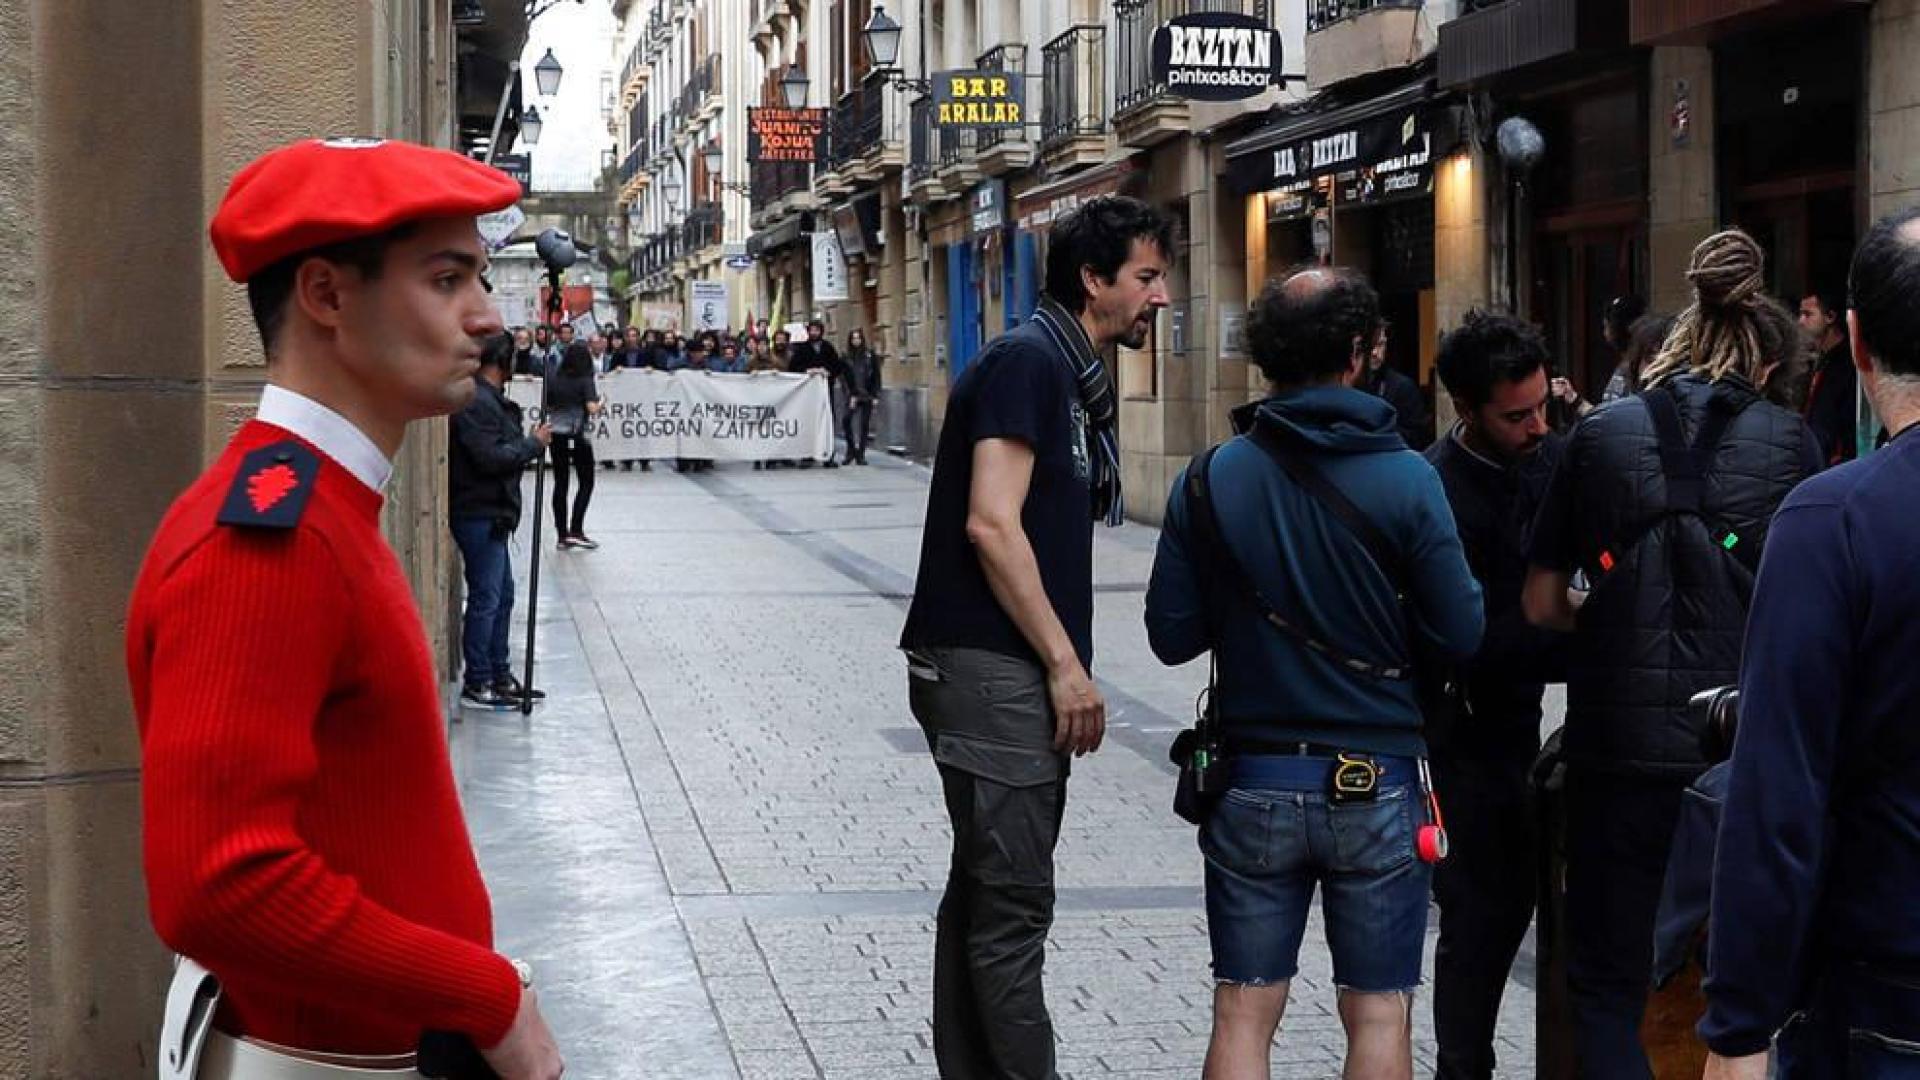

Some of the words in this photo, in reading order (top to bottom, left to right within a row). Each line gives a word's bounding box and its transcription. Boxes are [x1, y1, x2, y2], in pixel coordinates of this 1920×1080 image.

[1169, 25, 1272, 68] BAZTAN
[952, 78, 1006, 97] BAR
[939, 102, 1019, 123] ARALAR
[655, 400, 681, 418] EZ
[713, 418, 799, 440] ZAITUGU
